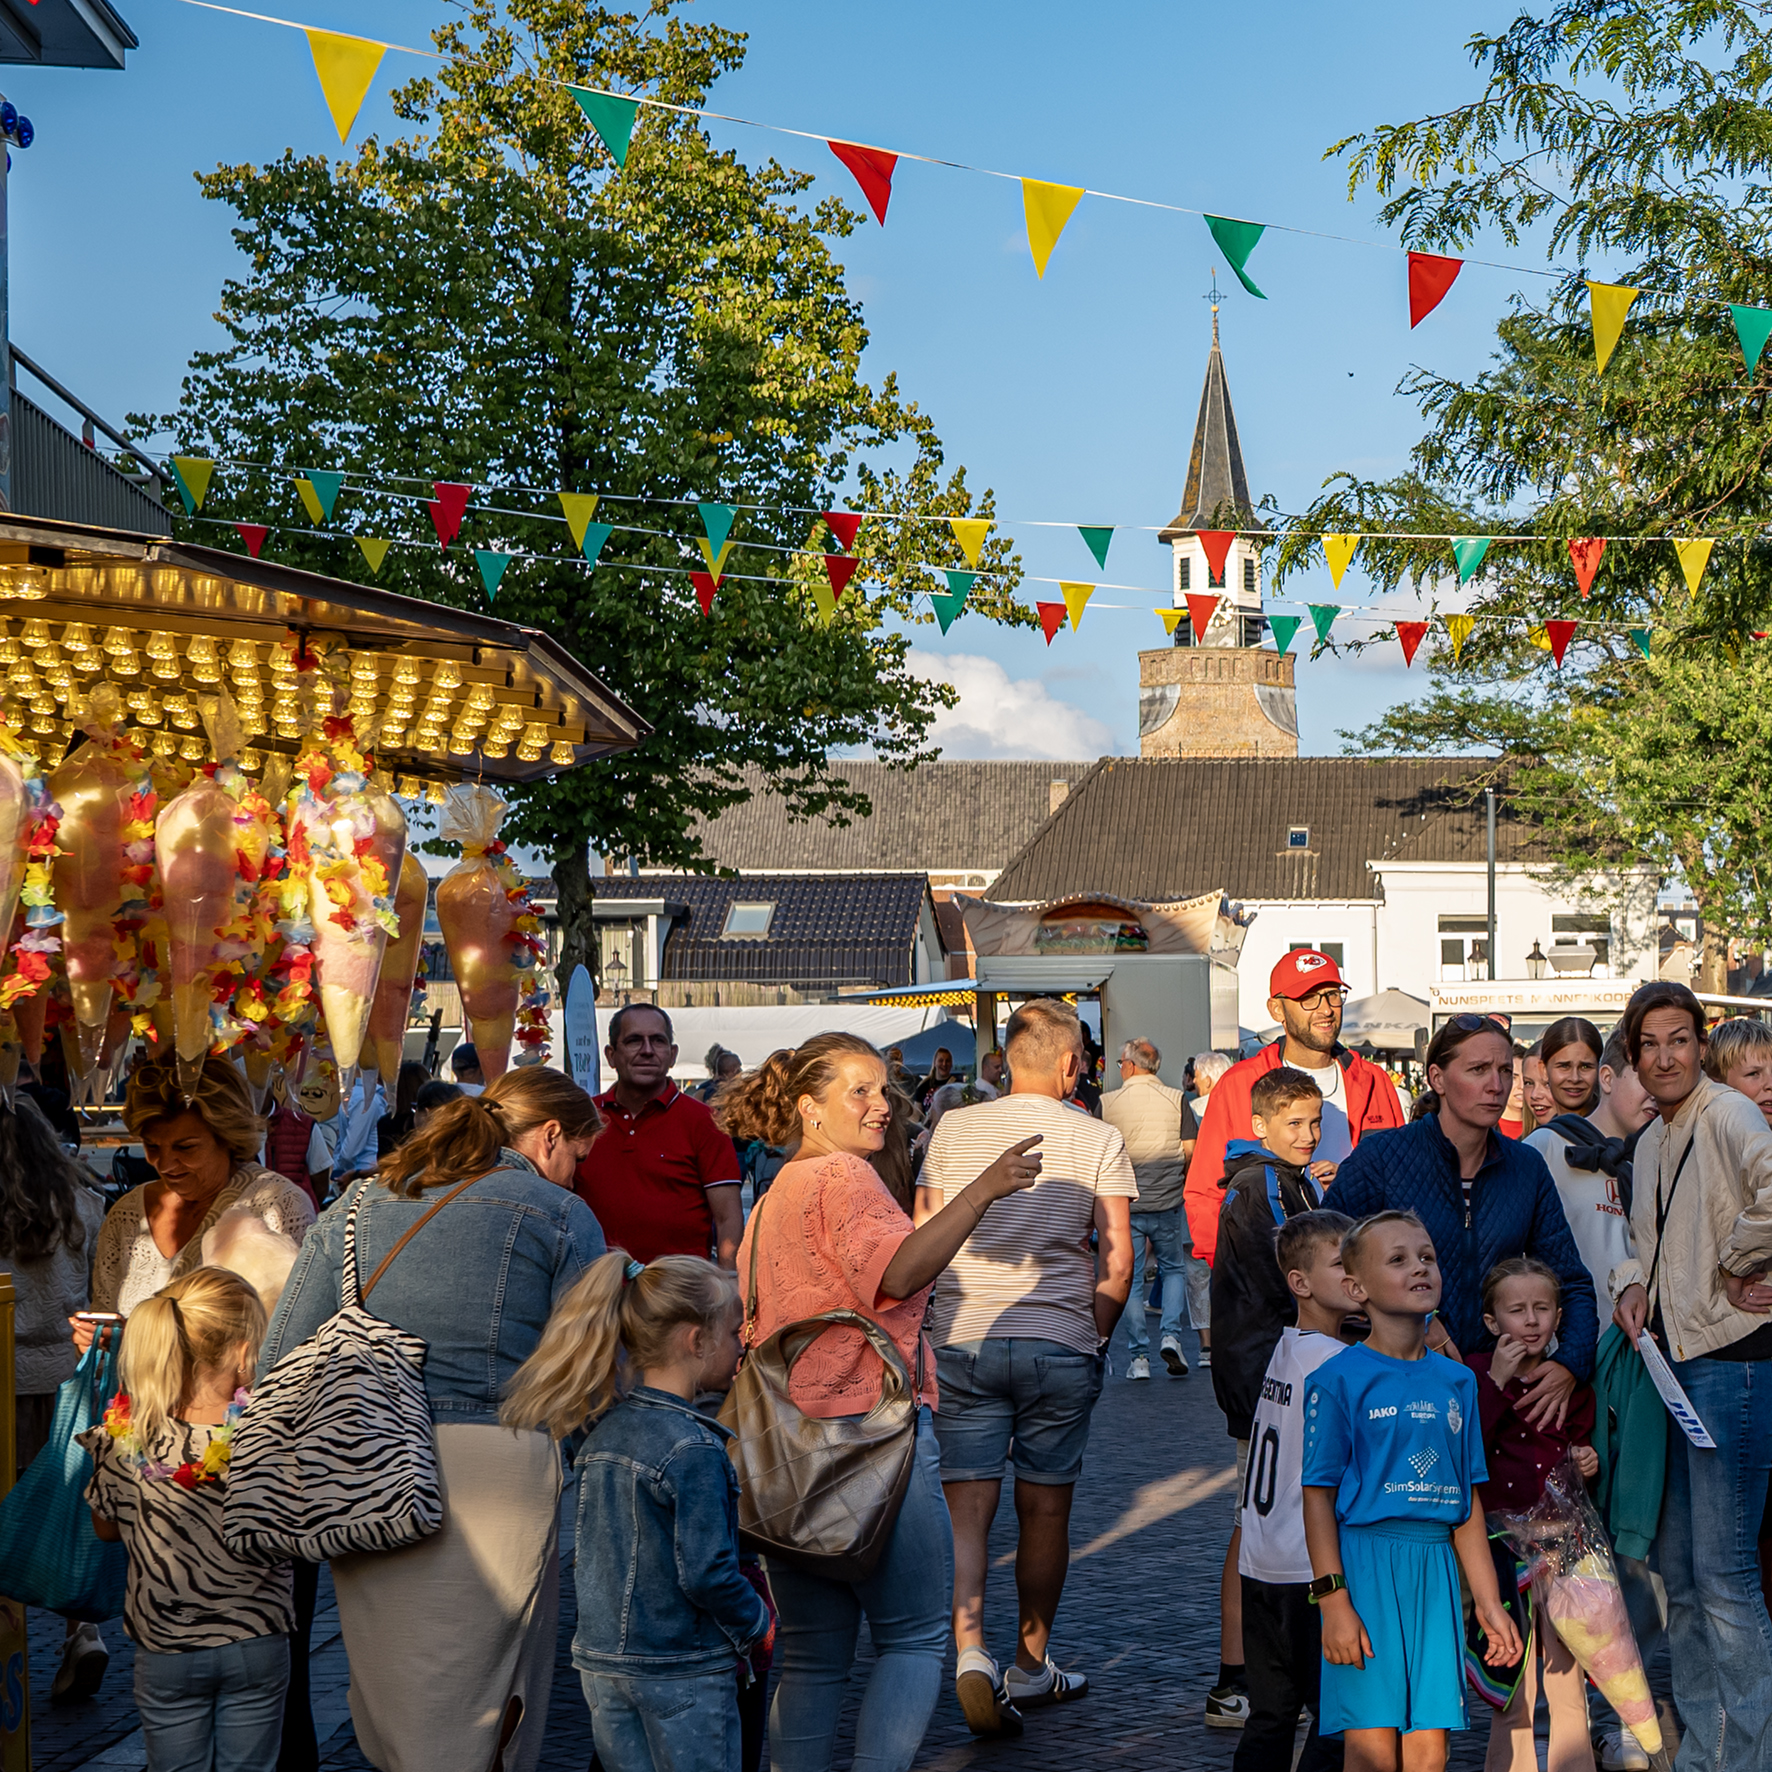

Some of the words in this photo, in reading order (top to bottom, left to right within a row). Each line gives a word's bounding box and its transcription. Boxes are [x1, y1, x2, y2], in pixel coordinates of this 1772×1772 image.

[1438, 994, 1524, 1006] NUNSPEETS
[1595, 1203, 1626, 1216] HON
[1368, 1405, 1398, 1420] JAKO
[1242, 1418, 1280, 1518] 10
